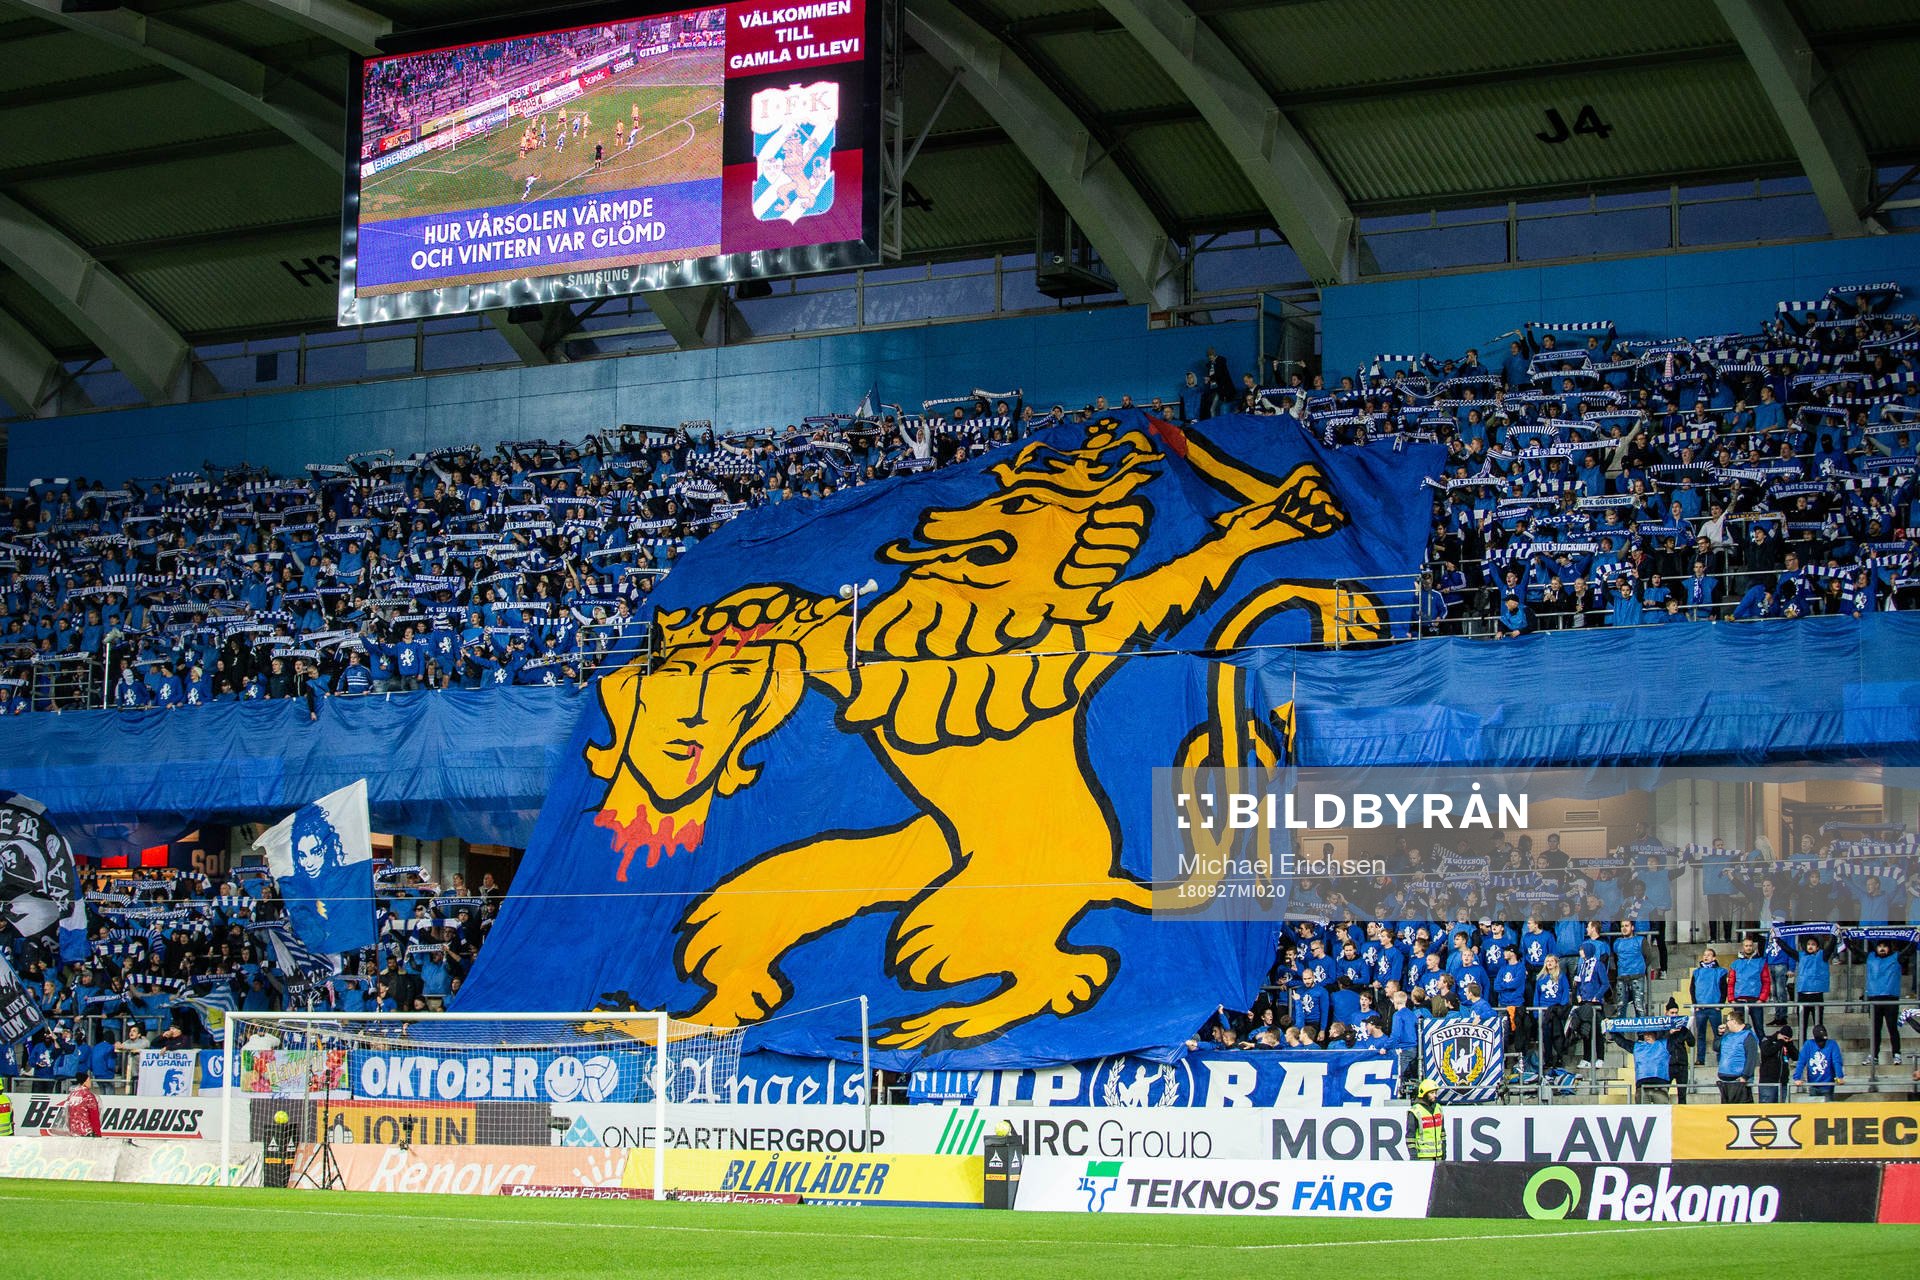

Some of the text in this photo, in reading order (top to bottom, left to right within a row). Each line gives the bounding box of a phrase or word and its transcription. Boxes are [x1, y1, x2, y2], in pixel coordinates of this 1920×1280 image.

[739, 0, 851, 29] VÄLKOMMEN
[775, 25, 814, 43] TILL
[730, 38, 860, 69] GAMLA ULLEVI
[1536, 104, 1614, 144] J4
[424, 197, 654, 245] HUR VÅRSOLEN VÄRMDE
[411, 221, 667, 271] OCH VINTERN VAR GLÖMD
[567, 268, 630, 288] SAMSUNG
[1436, 1026, 1490, 1043] SUPRAS
[1614, 1016, 1671, 1026] GAMLA ULLEVI
[141, 1059, 193, 1068] AV GRANIT
[146, 1052, 160, 1060] EN
[361, 1056, 539, 1099] OKTOBER
[680, 1056, 866, 1105] Angels
[1099, 1119, 1213, 1159] Group
[1273, 1116, 1657, 1162] MORIS LAW
[368, 1148, 536, 1195] Renova
[720, 1153, 890, 1195] BLÅKLÄDER
[1126, 1176, 1394, 1212] TEKNOS FÄRG
[1588, 1167, 1780, 1223] Rekomo
